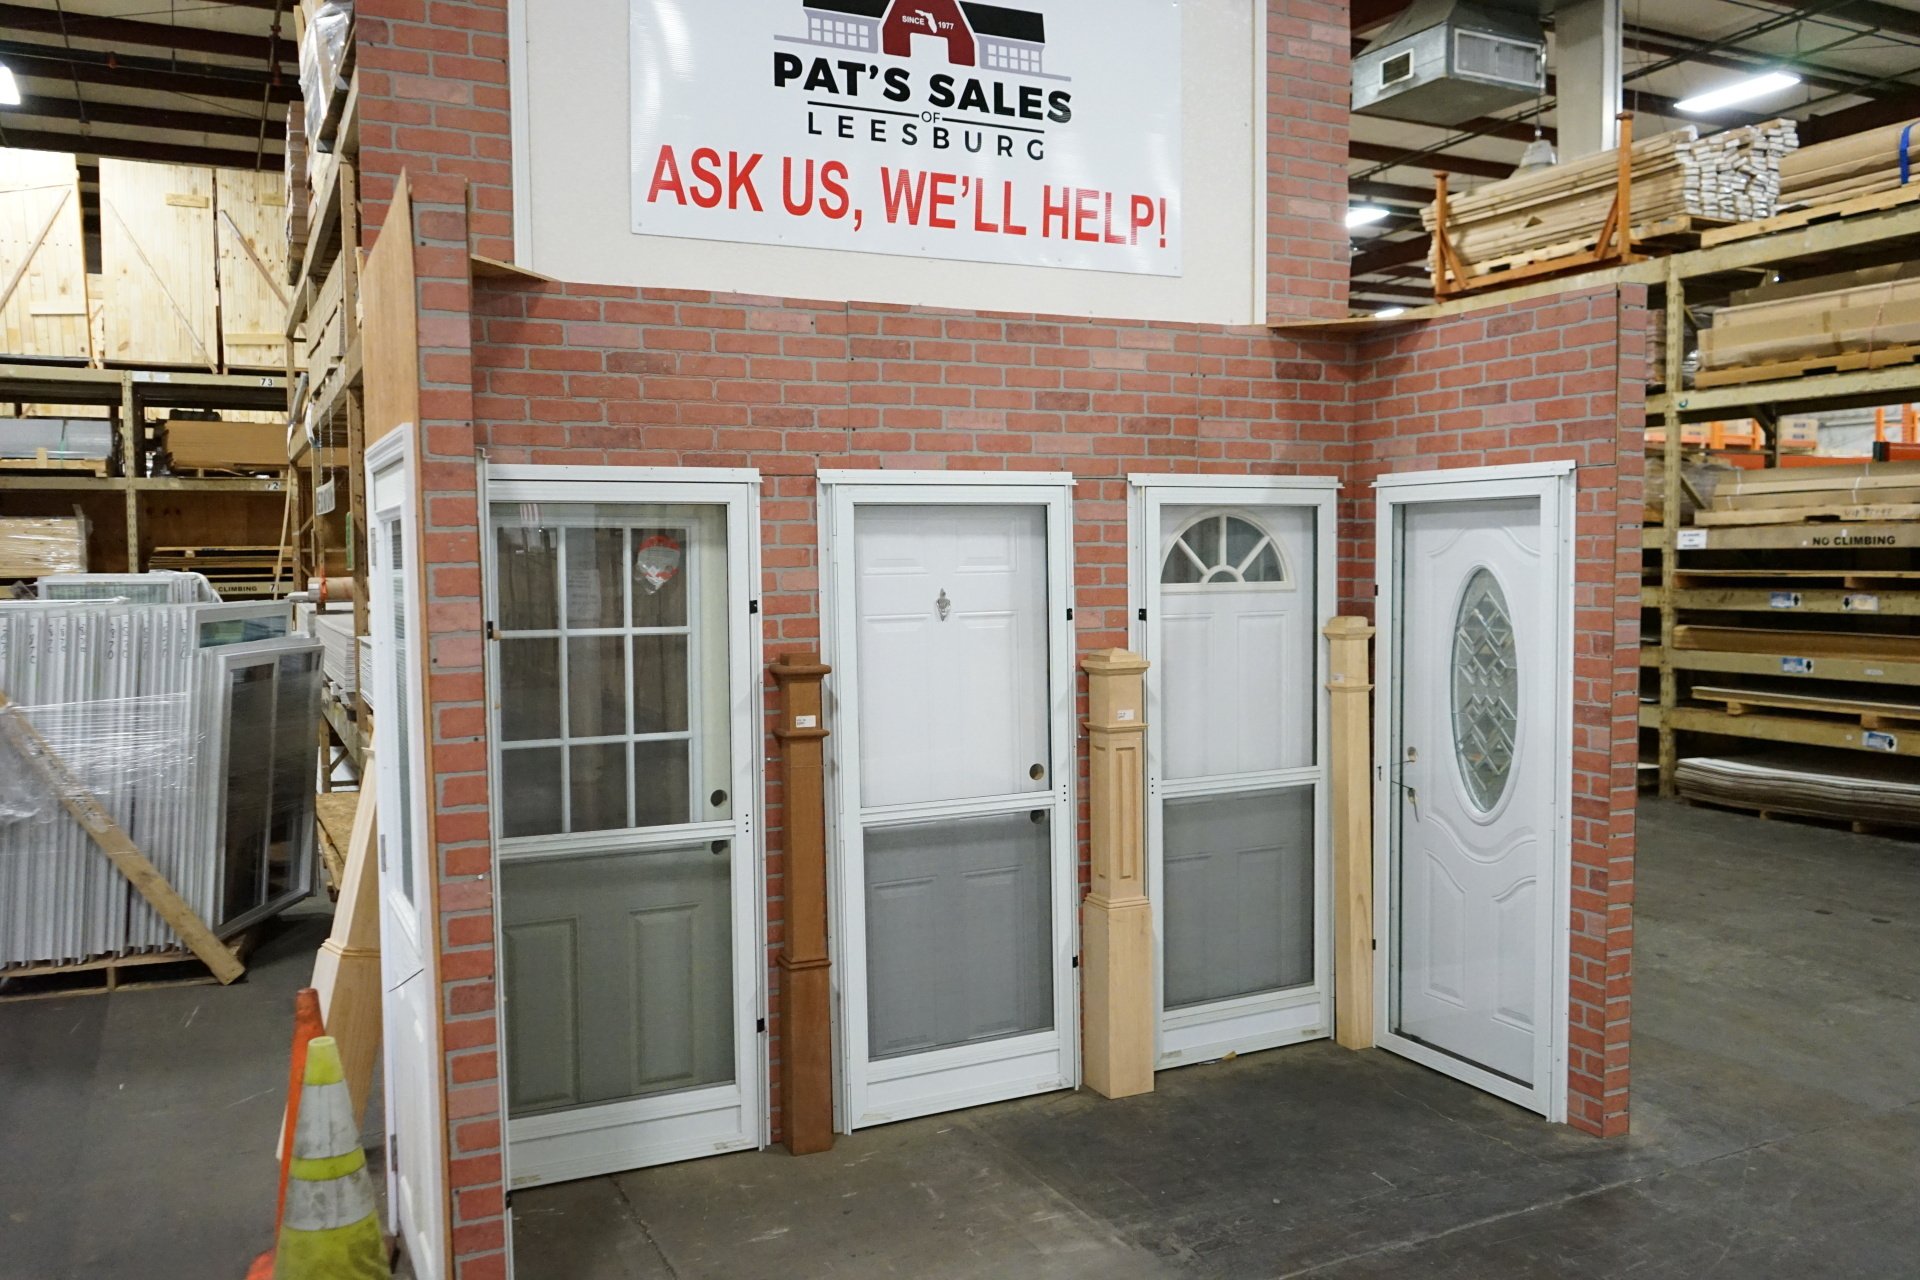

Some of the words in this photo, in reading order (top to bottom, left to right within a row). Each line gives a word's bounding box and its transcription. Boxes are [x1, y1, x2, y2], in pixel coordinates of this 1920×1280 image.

[901, 15, 925, 25] SINCE
[938, 21, 954, 30] 1977
[773, 51, 911, 103] PAT'S
[928, 73, 1072, 124] SALES
[921, 111, 941, 123] OF
[808, 111, 1044, 161] LEESBURG
[647, 144, 764, 213] ASK
[782, 156, 863, 231] US,
[880, 166, 1027, 236] WE'LL
[1042, 184, 1167, 248] HELP!
[261, 377, 273, 386] 73
[1812, 537, 1830, 546] NO
[1833, 535, 1896, 546] CLIMBING
[217, 585, 258, 593] CLIMBING
